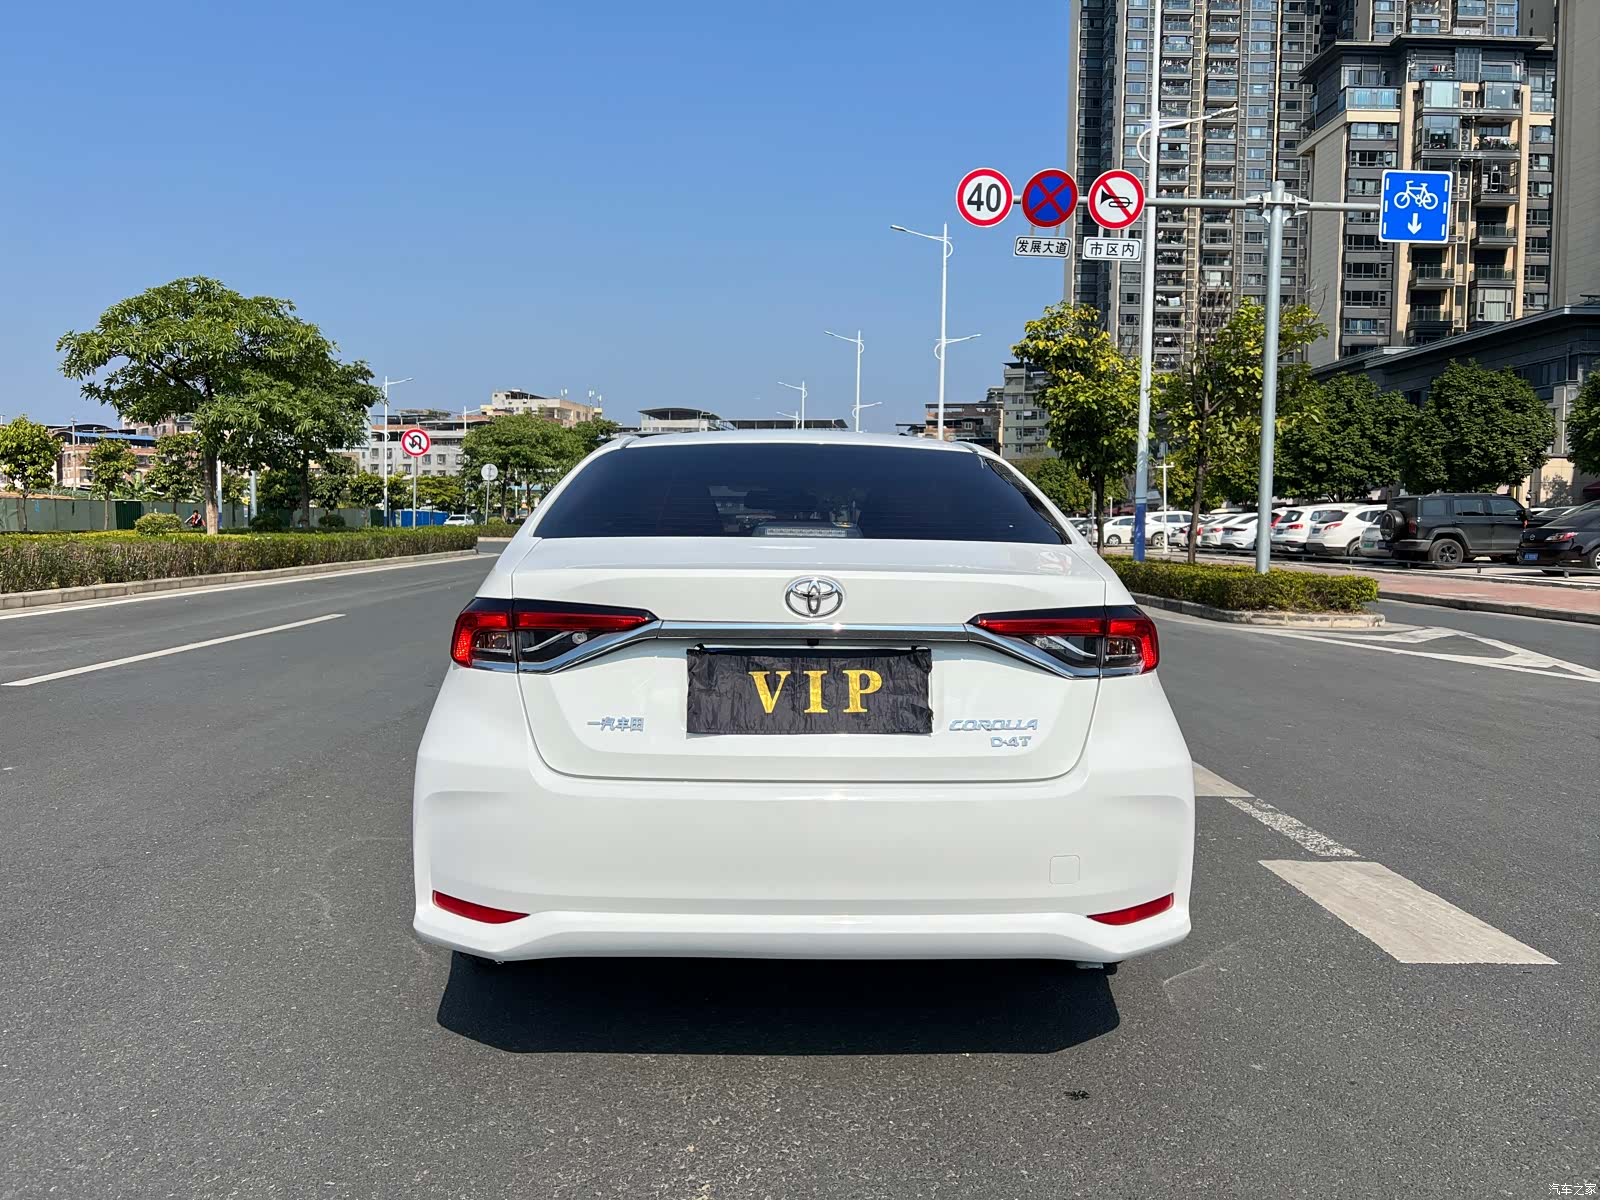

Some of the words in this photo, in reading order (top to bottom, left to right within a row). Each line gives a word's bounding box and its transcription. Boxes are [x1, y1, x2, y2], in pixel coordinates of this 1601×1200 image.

[967, 183, 1001, 212] 40
[1017, 240, 1068, 255] 发展大道
[1090, 242, 1135, 257] 市区内
[748, 669, 883, 714] VIP
[587, 716, 644, 732] 一汽丰田
[949, 719, 1038, 732] COROLLA
